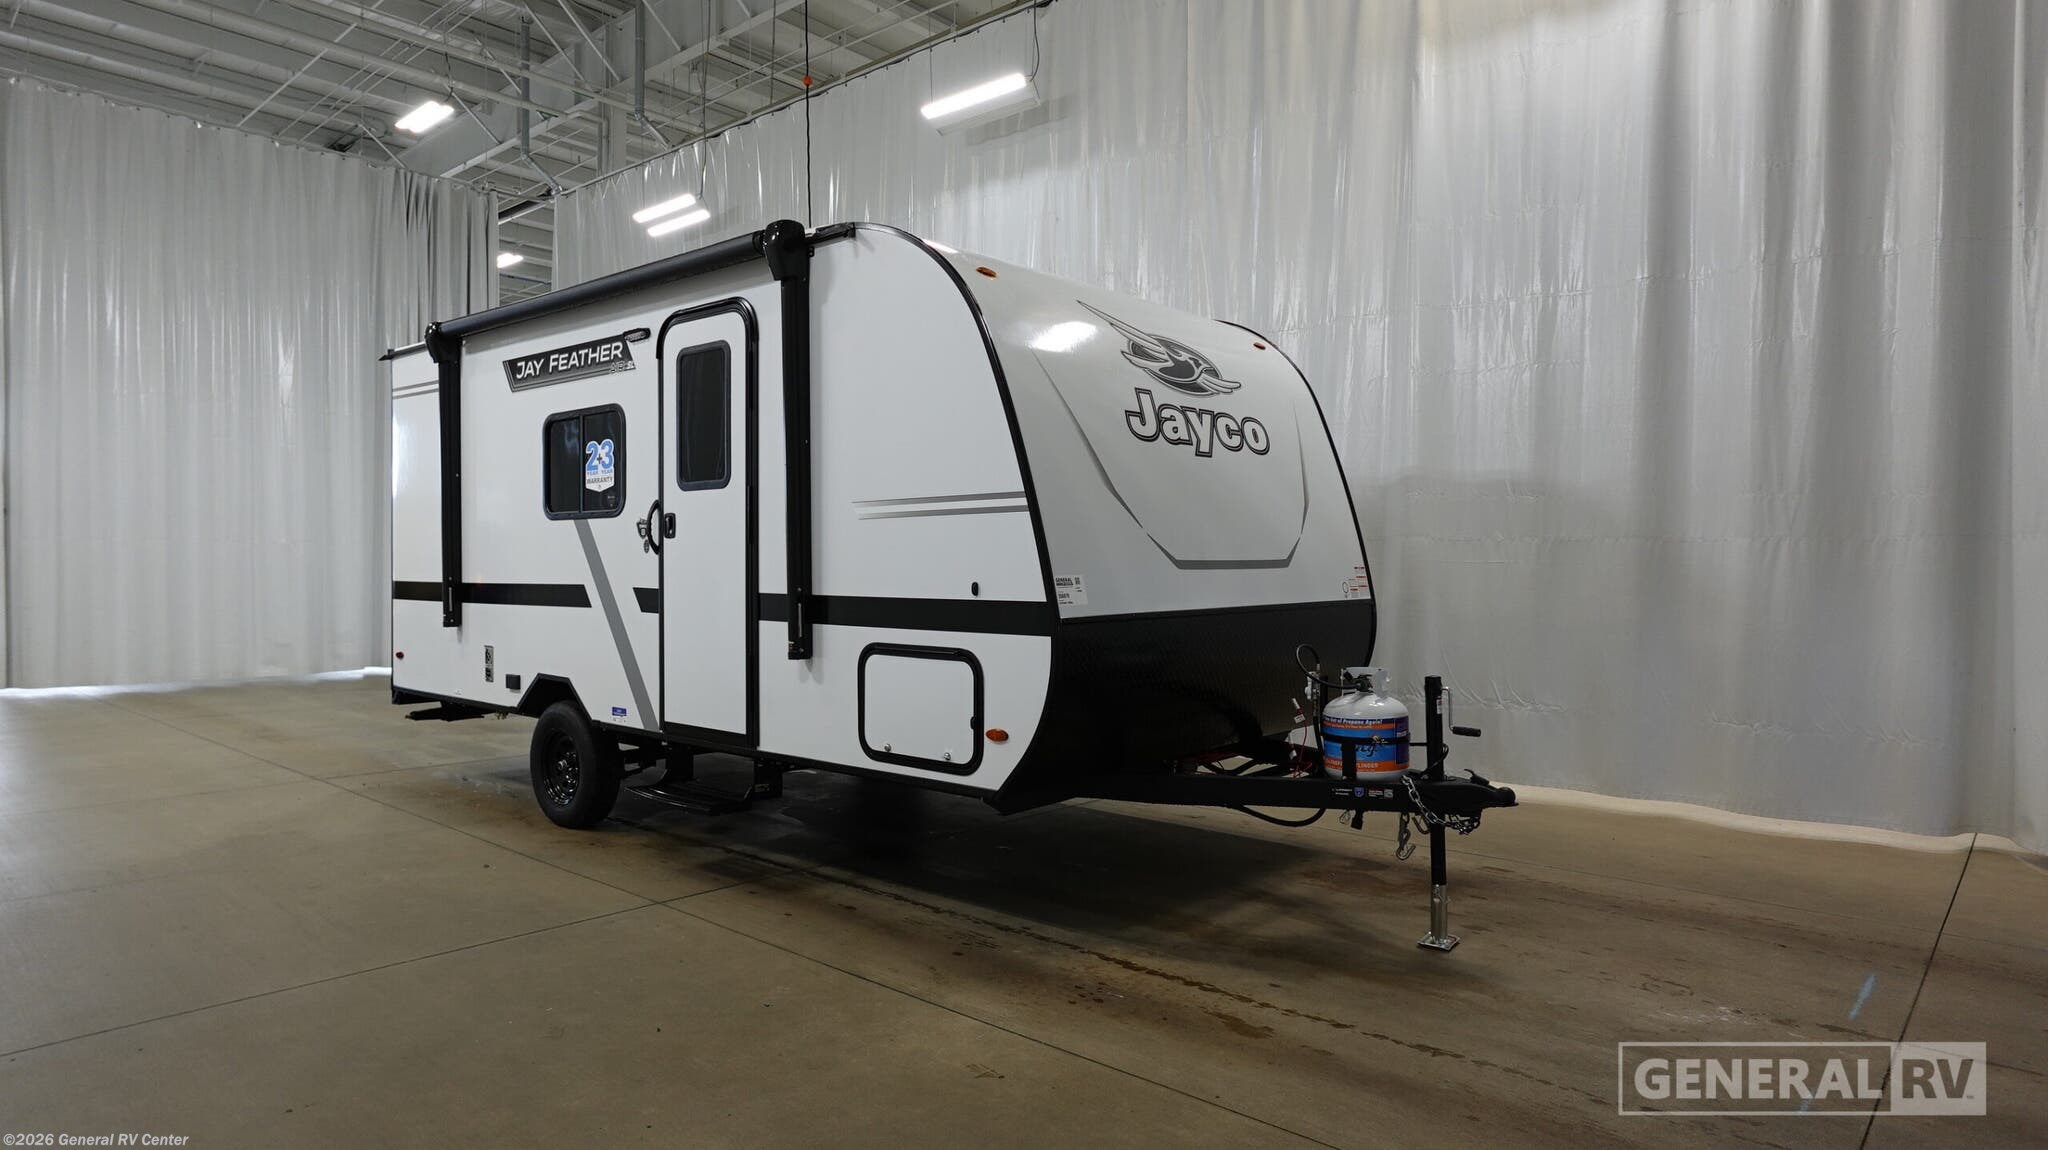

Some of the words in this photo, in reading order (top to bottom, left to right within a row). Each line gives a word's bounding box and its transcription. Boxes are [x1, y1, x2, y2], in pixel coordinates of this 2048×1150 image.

[516, 358, 544, 380] JAY
[549, 341, 623, 373] FEATHER
[1124, 387, 1270, 458] Jayco
[587, 476, 613, 484] WARRANTY
